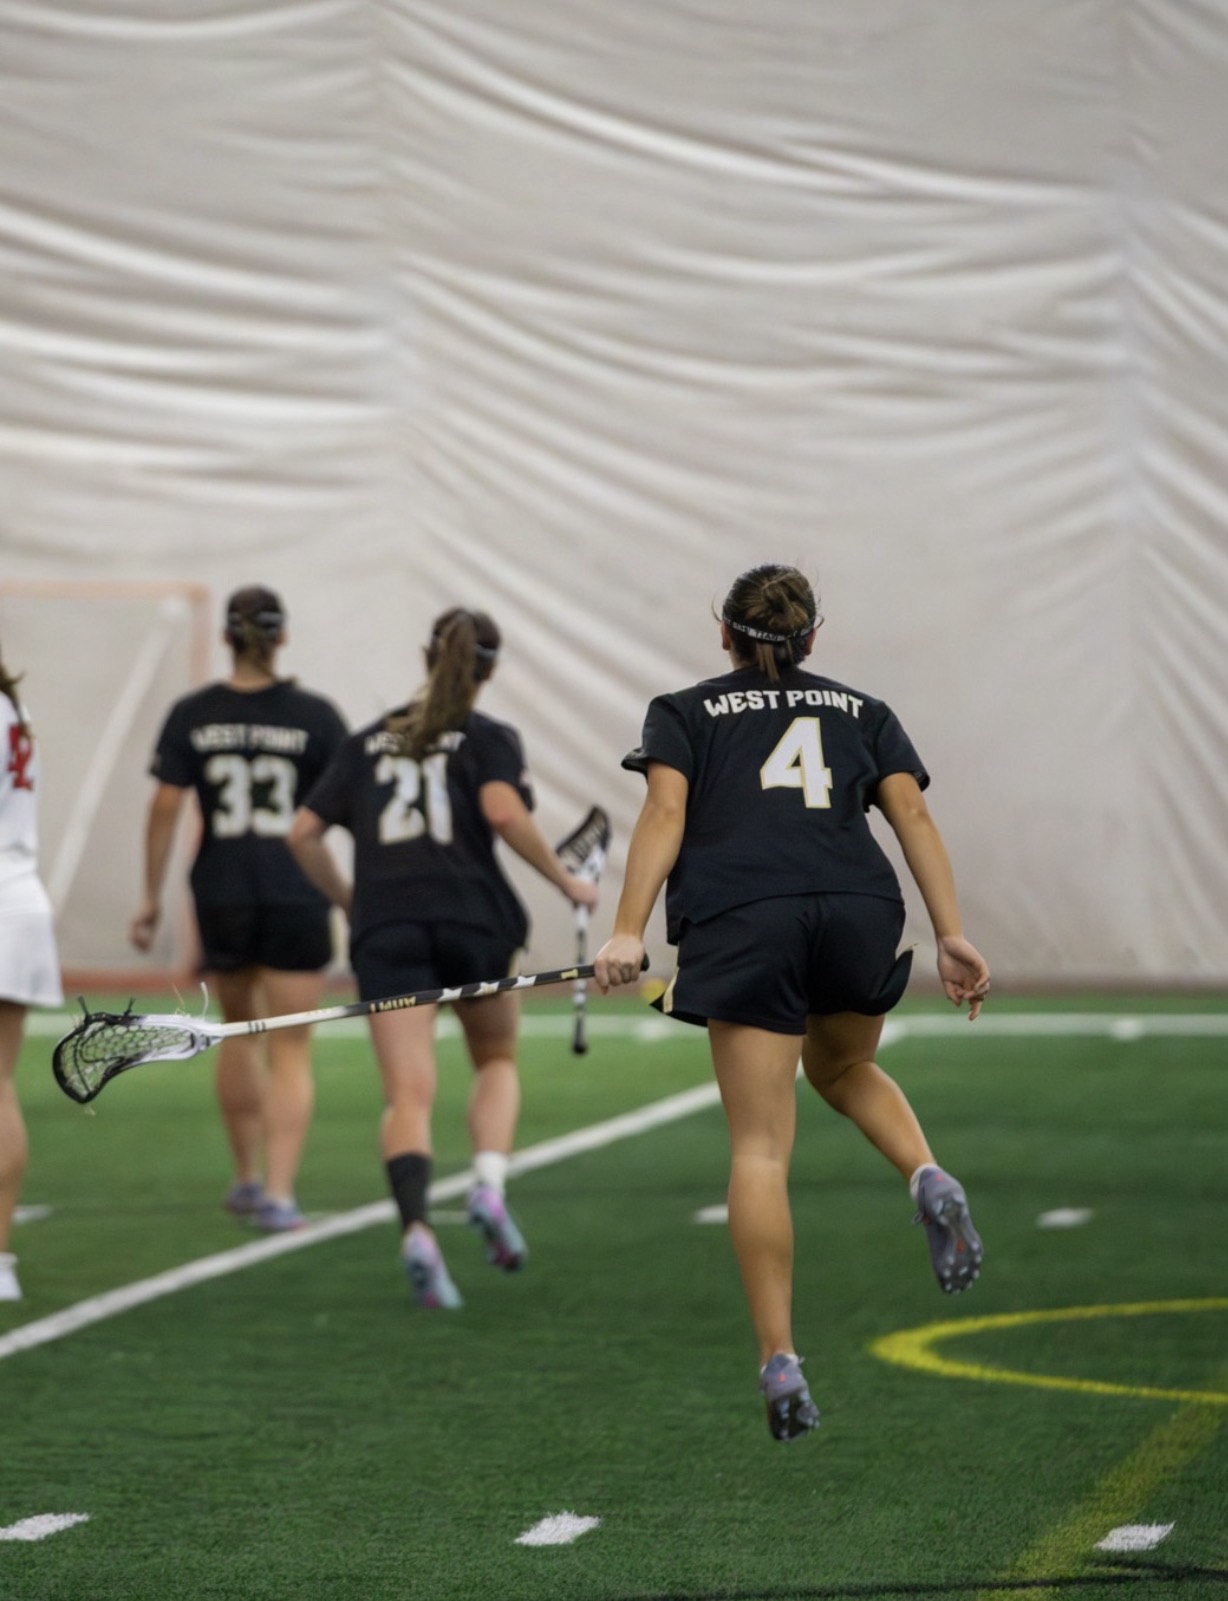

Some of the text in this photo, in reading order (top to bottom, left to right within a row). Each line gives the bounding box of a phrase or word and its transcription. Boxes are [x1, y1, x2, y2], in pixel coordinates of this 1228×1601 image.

[704, 689, 864, 720] WEST POINT
[204, 753, 298, 837] 33
[375, 752, 454, 845] 21
[759, 716, 833, 809] 4
